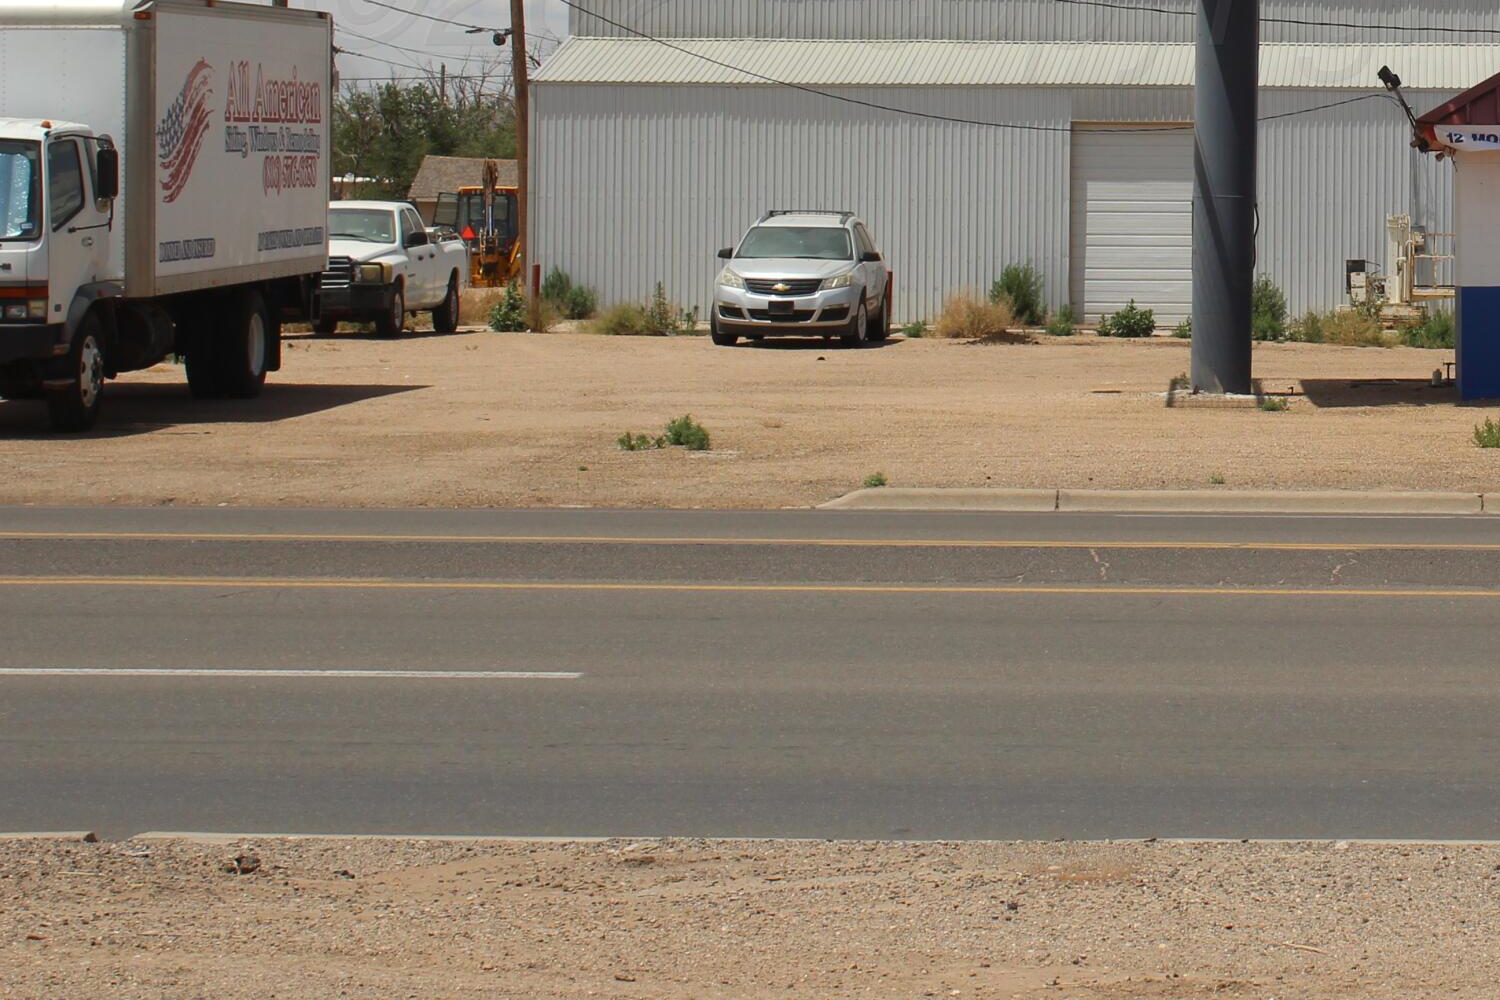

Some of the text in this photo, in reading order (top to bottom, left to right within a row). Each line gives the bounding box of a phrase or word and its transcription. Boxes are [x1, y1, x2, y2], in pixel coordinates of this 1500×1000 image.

[225, 61, 321, 123] All American
[1446, 132, 1464, 144] 12
